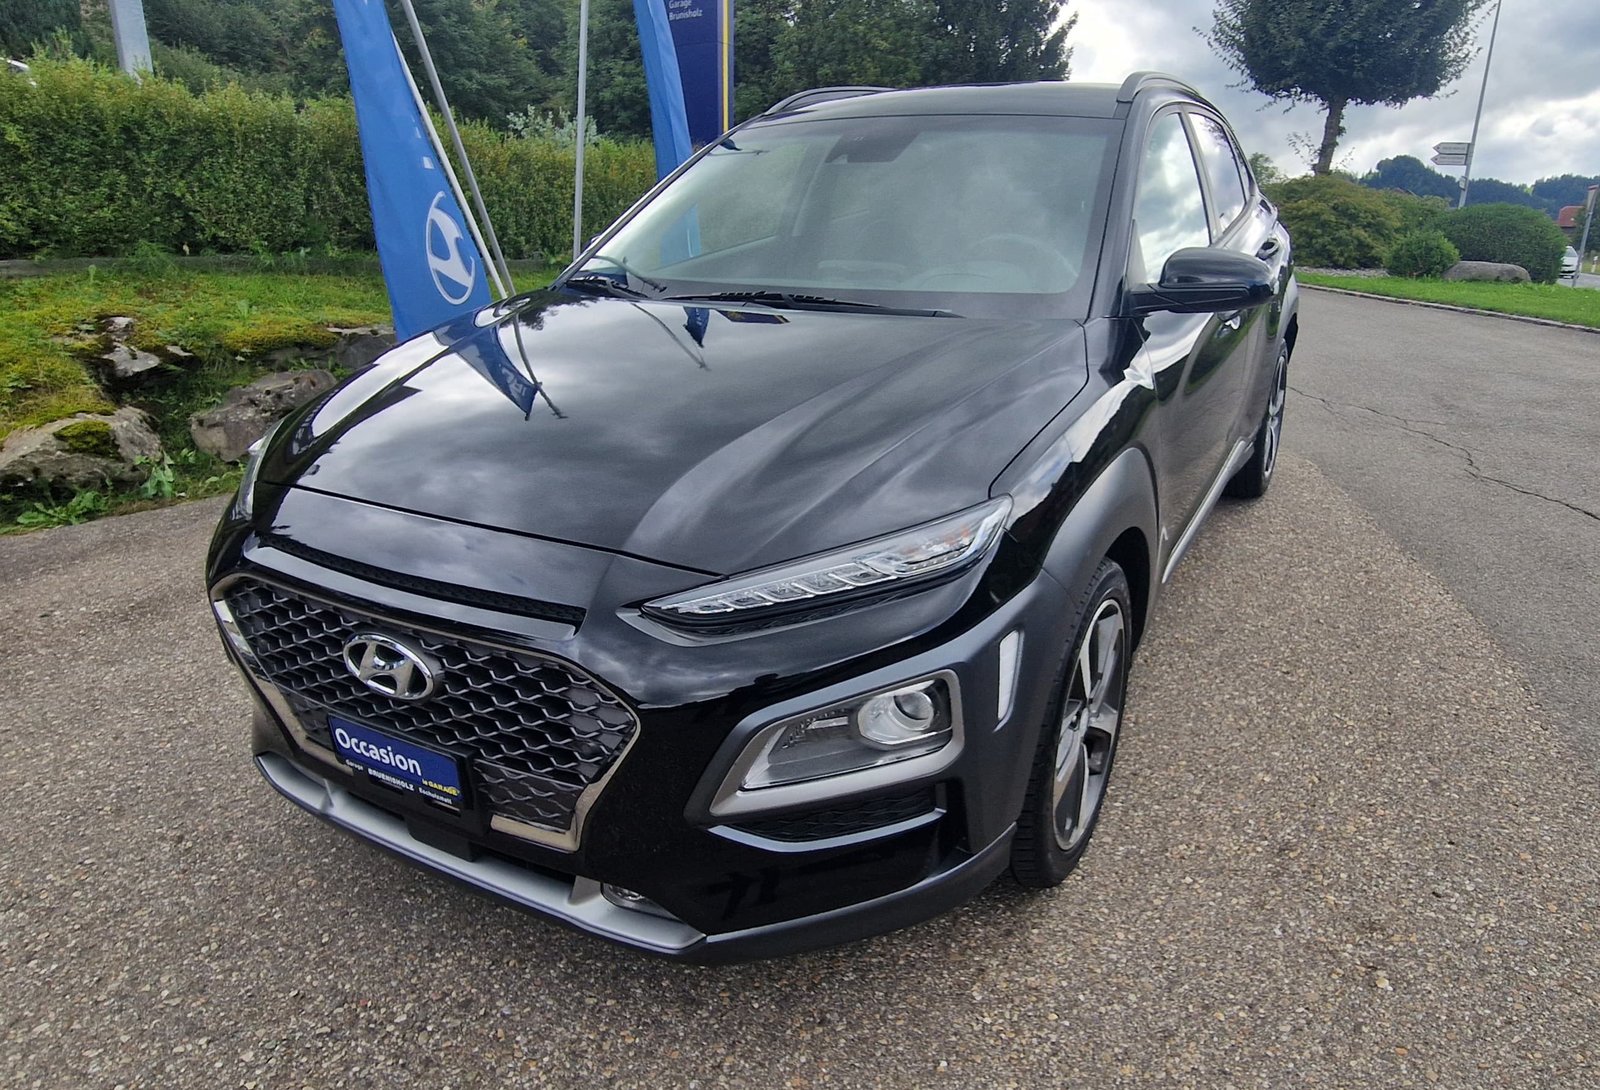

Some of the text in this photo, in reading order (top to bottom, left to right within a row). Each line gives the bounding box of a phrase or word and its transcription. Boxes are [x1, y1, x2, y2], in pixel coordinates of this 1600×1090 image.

[668, 0, 692, 9] Garage
[335, 728, 421, 776] Occasion
[428, 781, 459, 797] GARAGE
